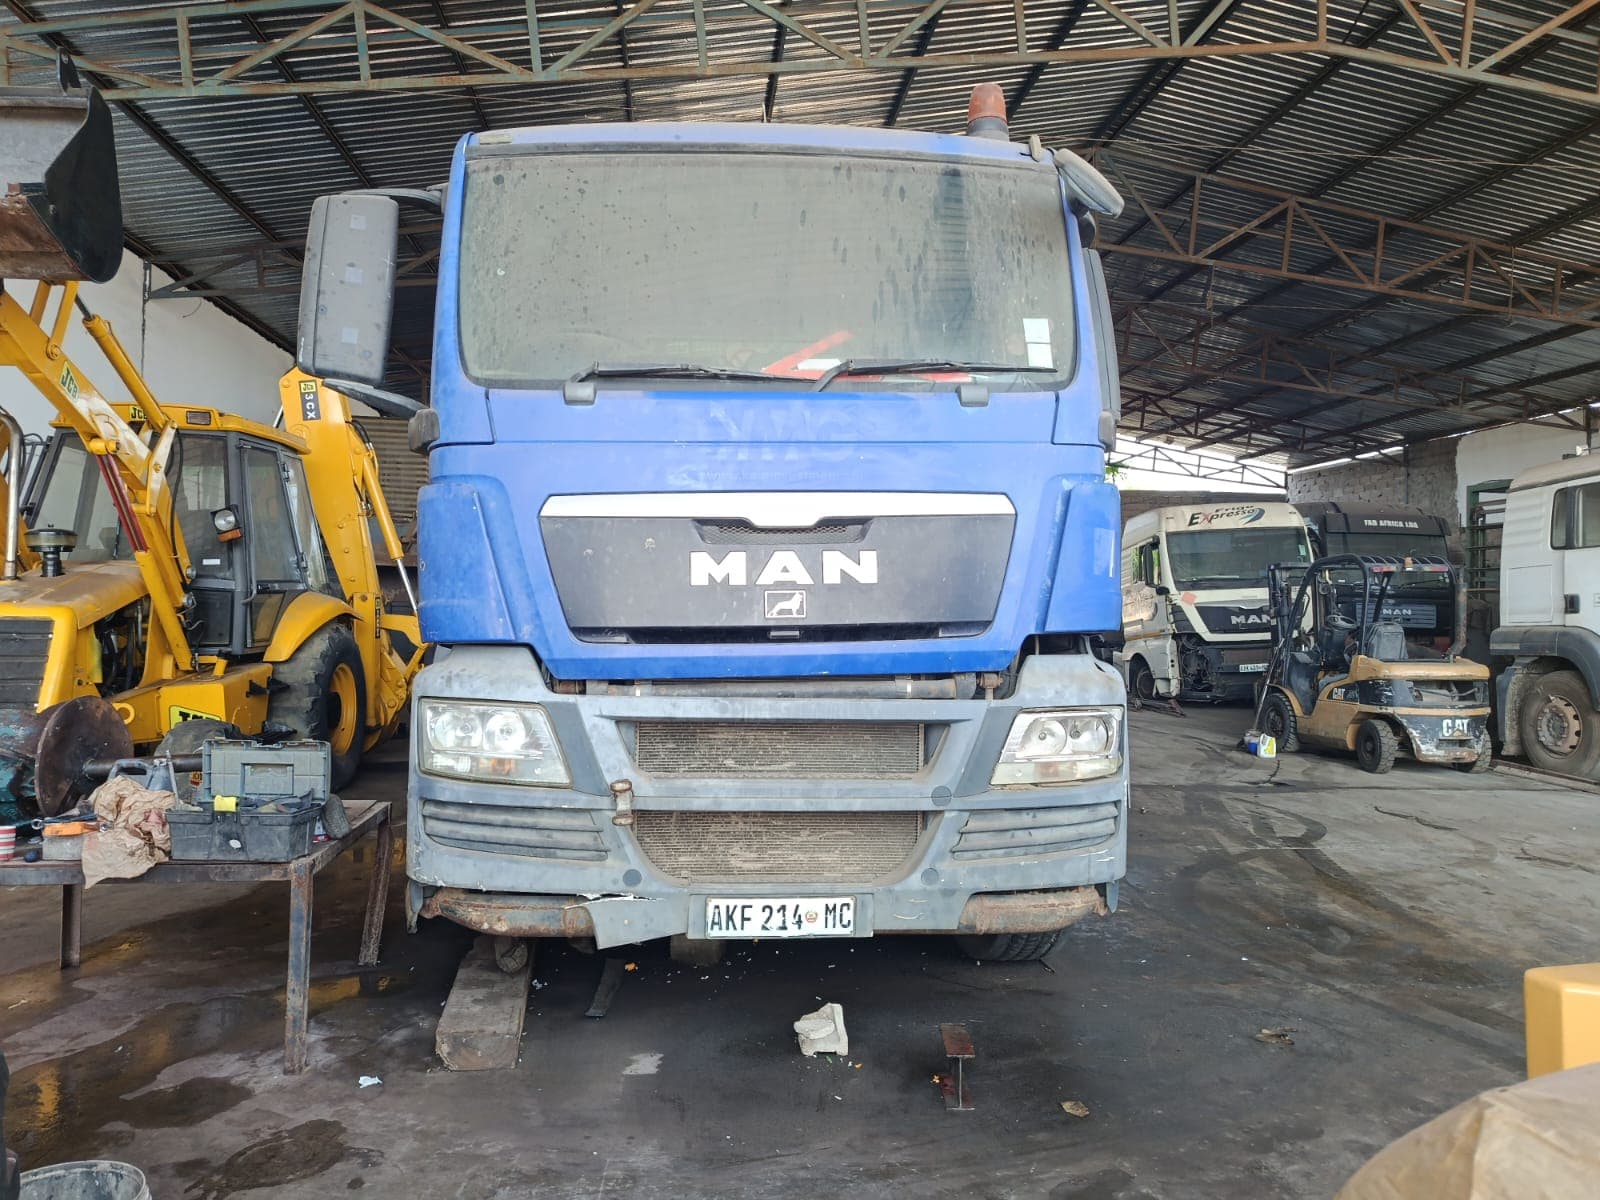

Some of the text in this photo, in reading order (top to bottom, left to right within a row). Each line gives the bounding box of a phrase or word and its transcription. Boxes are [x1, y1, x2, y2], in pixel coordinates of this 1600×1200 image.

[61, 366, 79, 399] JCB
[690, 549, 878, 586] MAN
[1382, 608, 1412, 616] MAN
[1332, 687, 1346, 700] CAT
[1442, 718, 1470, 737] CAT
[709, 902, 852, 932] AKF 214 MC
